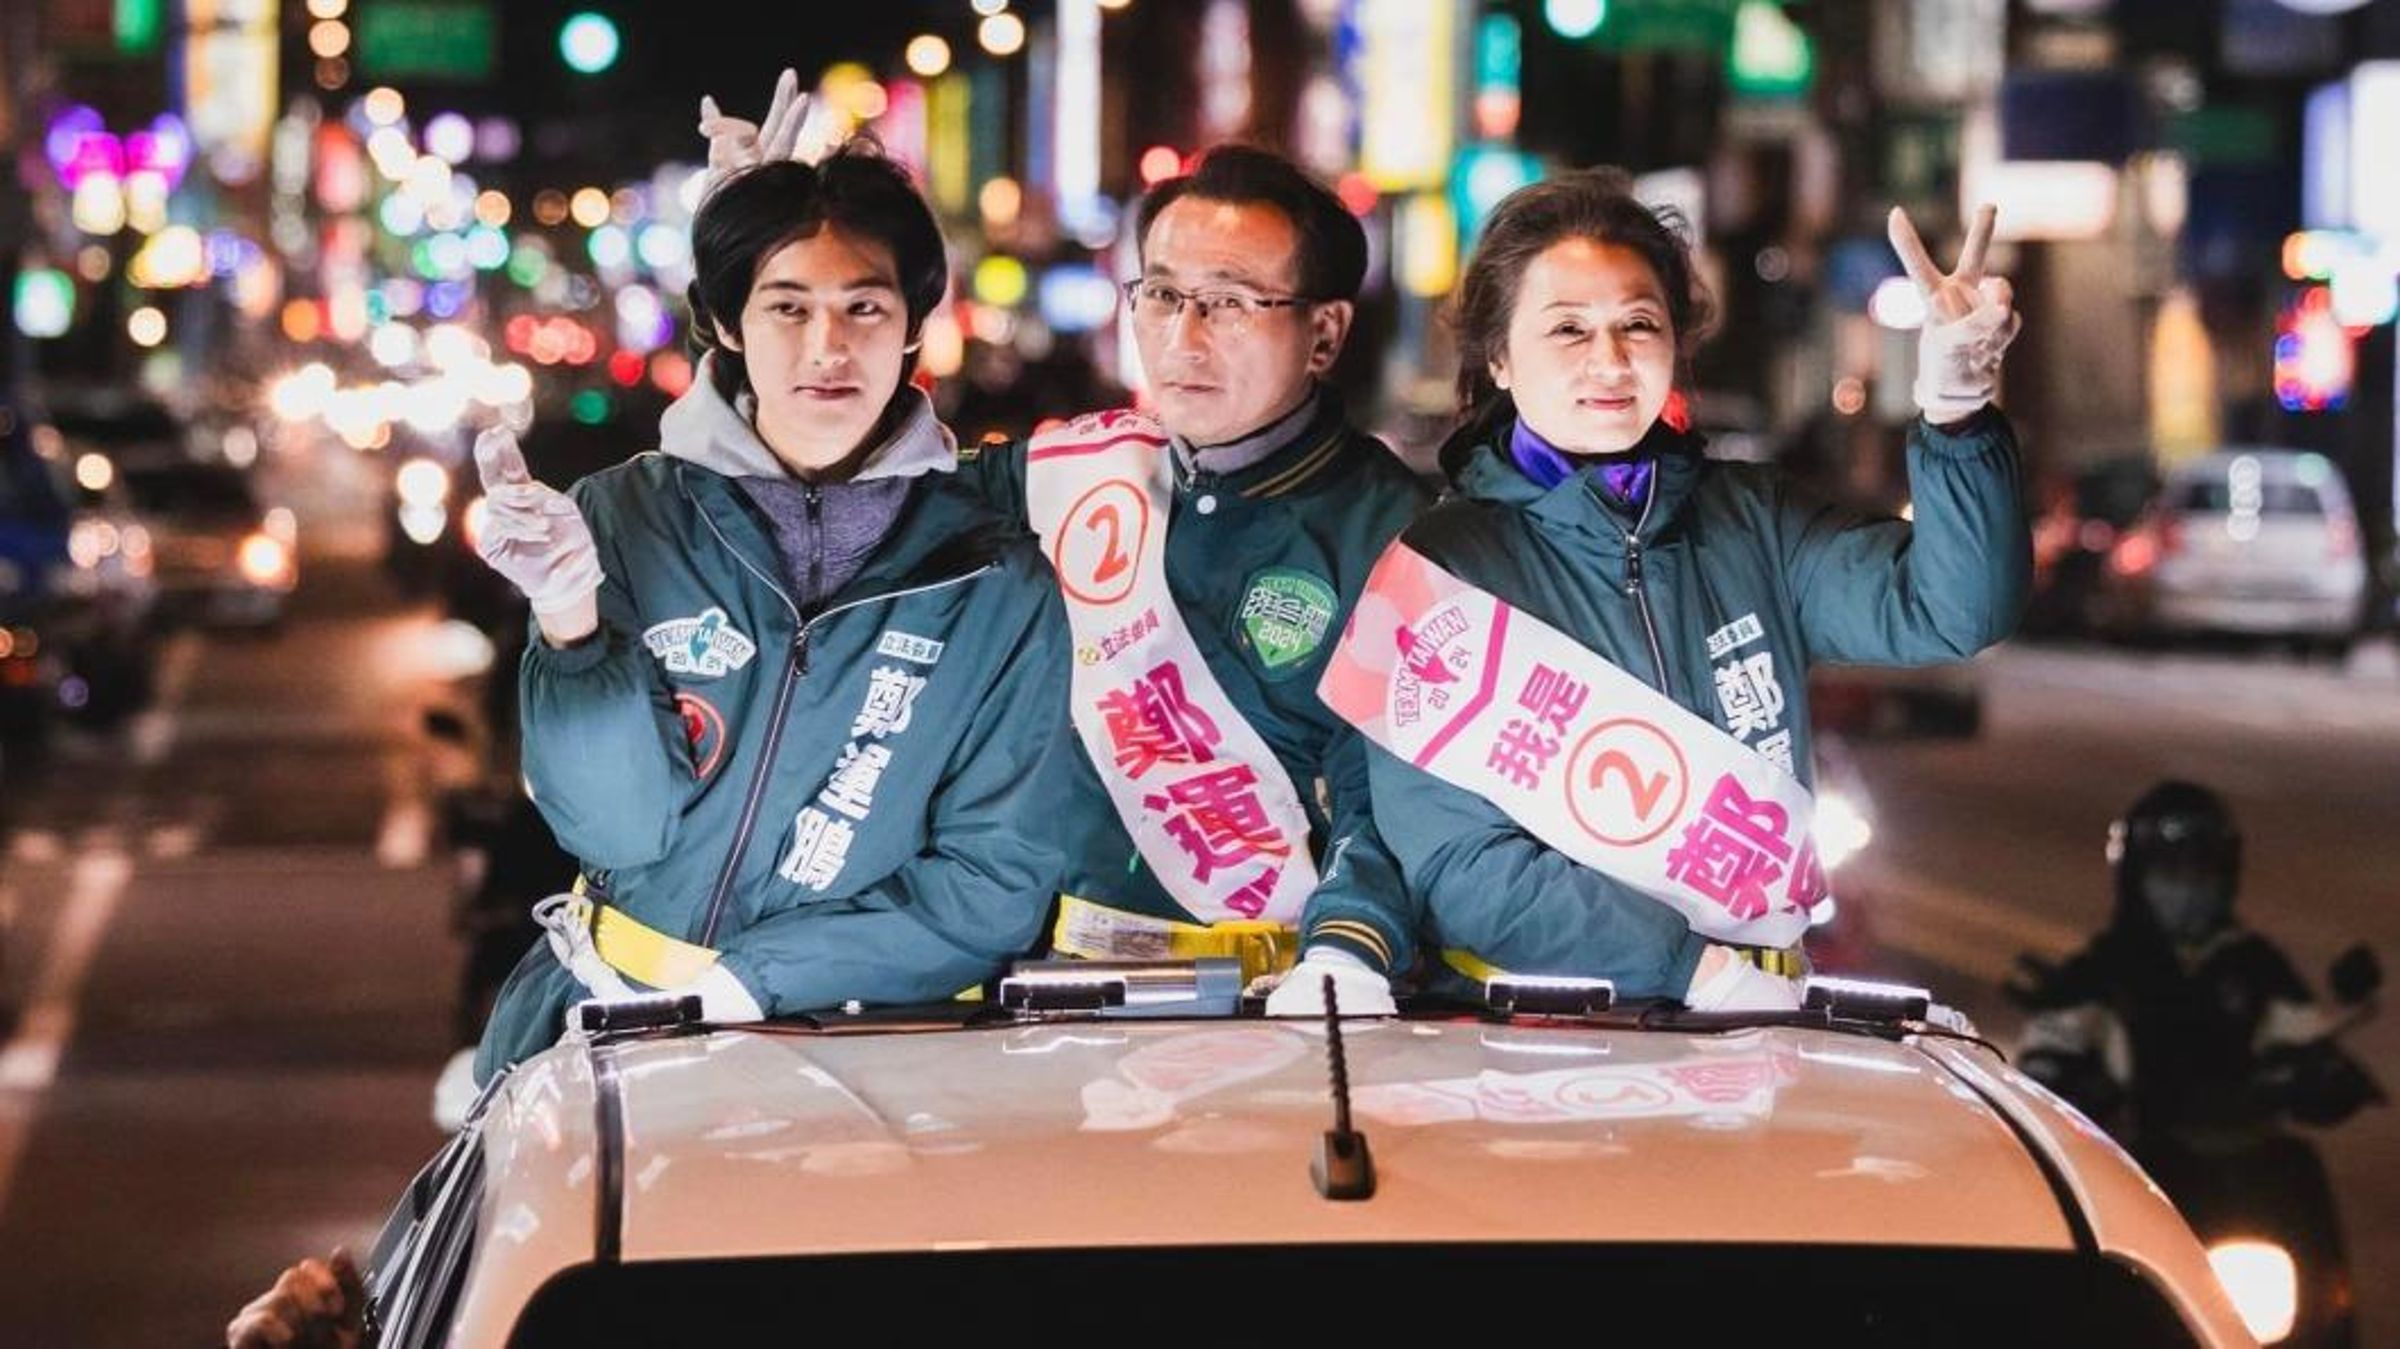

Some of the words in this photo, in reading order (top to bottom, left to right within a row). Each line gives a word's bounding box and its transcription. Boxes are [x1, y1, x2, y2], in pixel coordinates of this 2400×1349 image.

[1086, 504, 1130, 584] 2
[1428, 687, 1451, 710] 20
[1449, 645, 1473, 669] 24
[1486, 662, 1591, 791] 我是
[1588, 748, 1671, 822] 2
